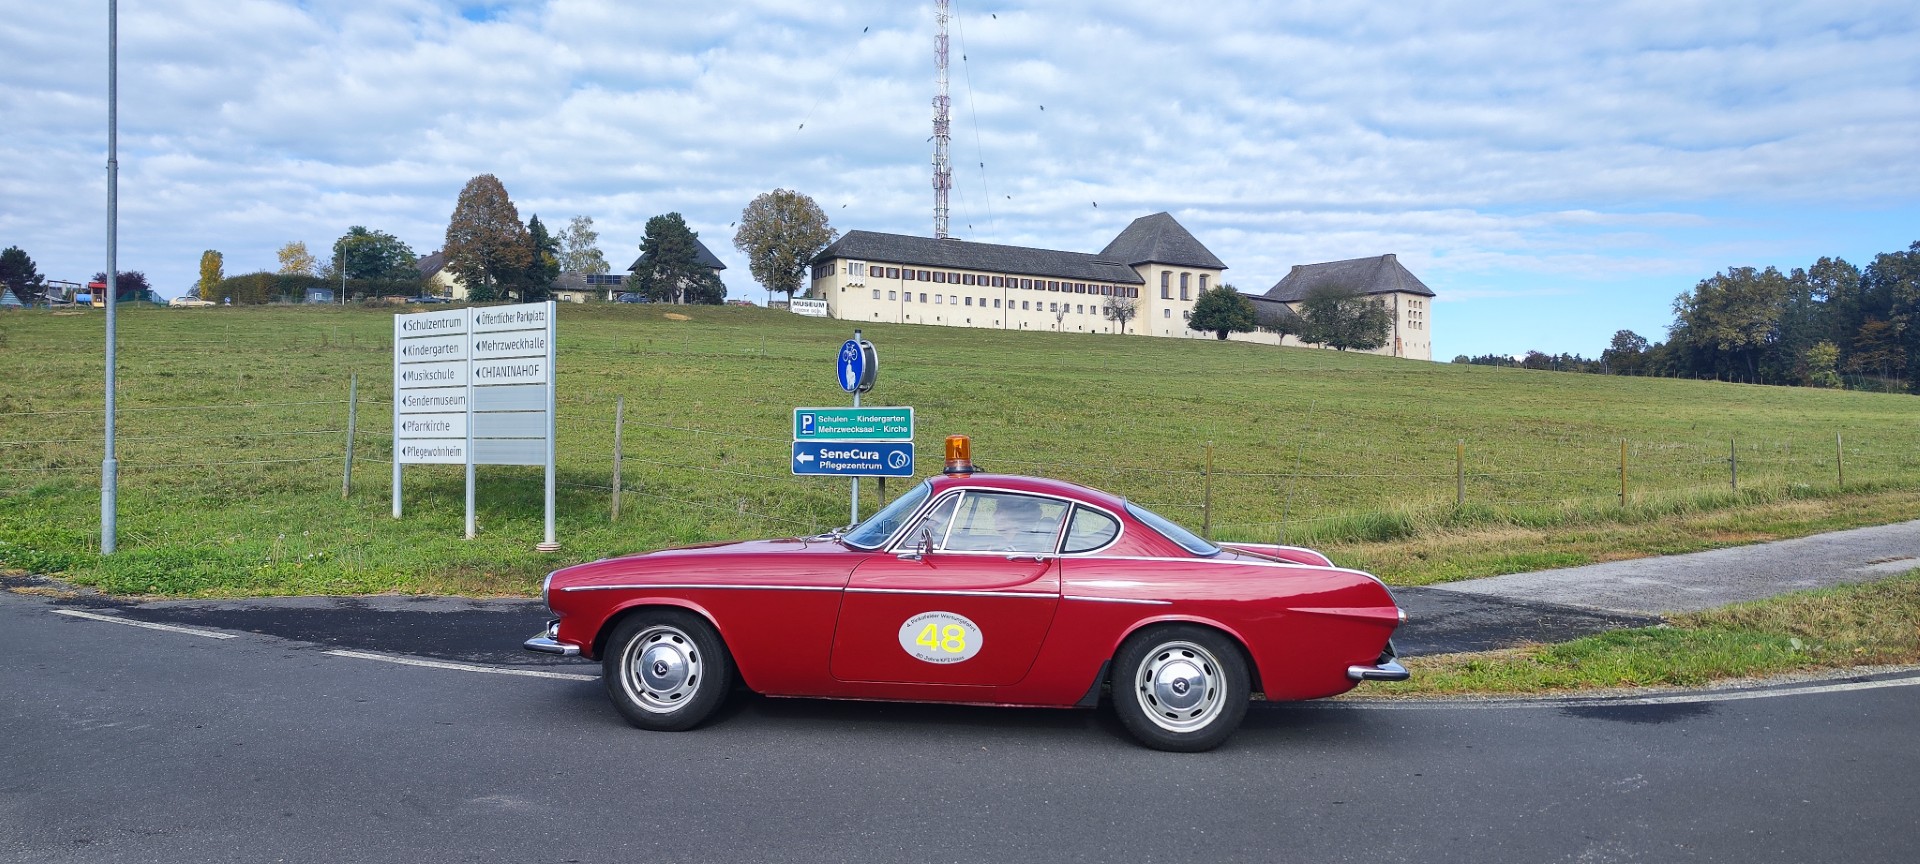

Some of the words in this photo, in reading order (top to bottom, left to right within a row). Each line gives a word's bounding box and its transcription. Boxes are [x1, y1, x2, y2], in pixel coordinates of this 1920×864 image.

[481, 311, 515, 325] Öffentlicher
[516, 310, 545, 324] Parkplatz
[408, 318, 462, 331] Schulzentrum
[408, 344, 459, 357] Kindergarten
[481, 337, 545, 352] Mehrzweckhalle
[407, 368, 455, 381] Musikschule
[481, 364, 540, 378] CHIANINAHOF
[407, 395, 466, 407] Sendermuseum
[407, 420, 451, 432] Pfarrkirche
[802, 415, 812, 429] P
[818, 415, 848, 423] Schulen
[857, 415, 906, 424] Kindergarten
[818, 425, 875, 434] Mehrzwecksaal
[883, 425, 908, 433] Kirche
[407, 445, 462, 459] Pflegewohnheim
[819, 449, 880, 460] SeneCura
[819, 461, 883, 471] Pflegezentrum
[915, 623, 966, 653] 48
